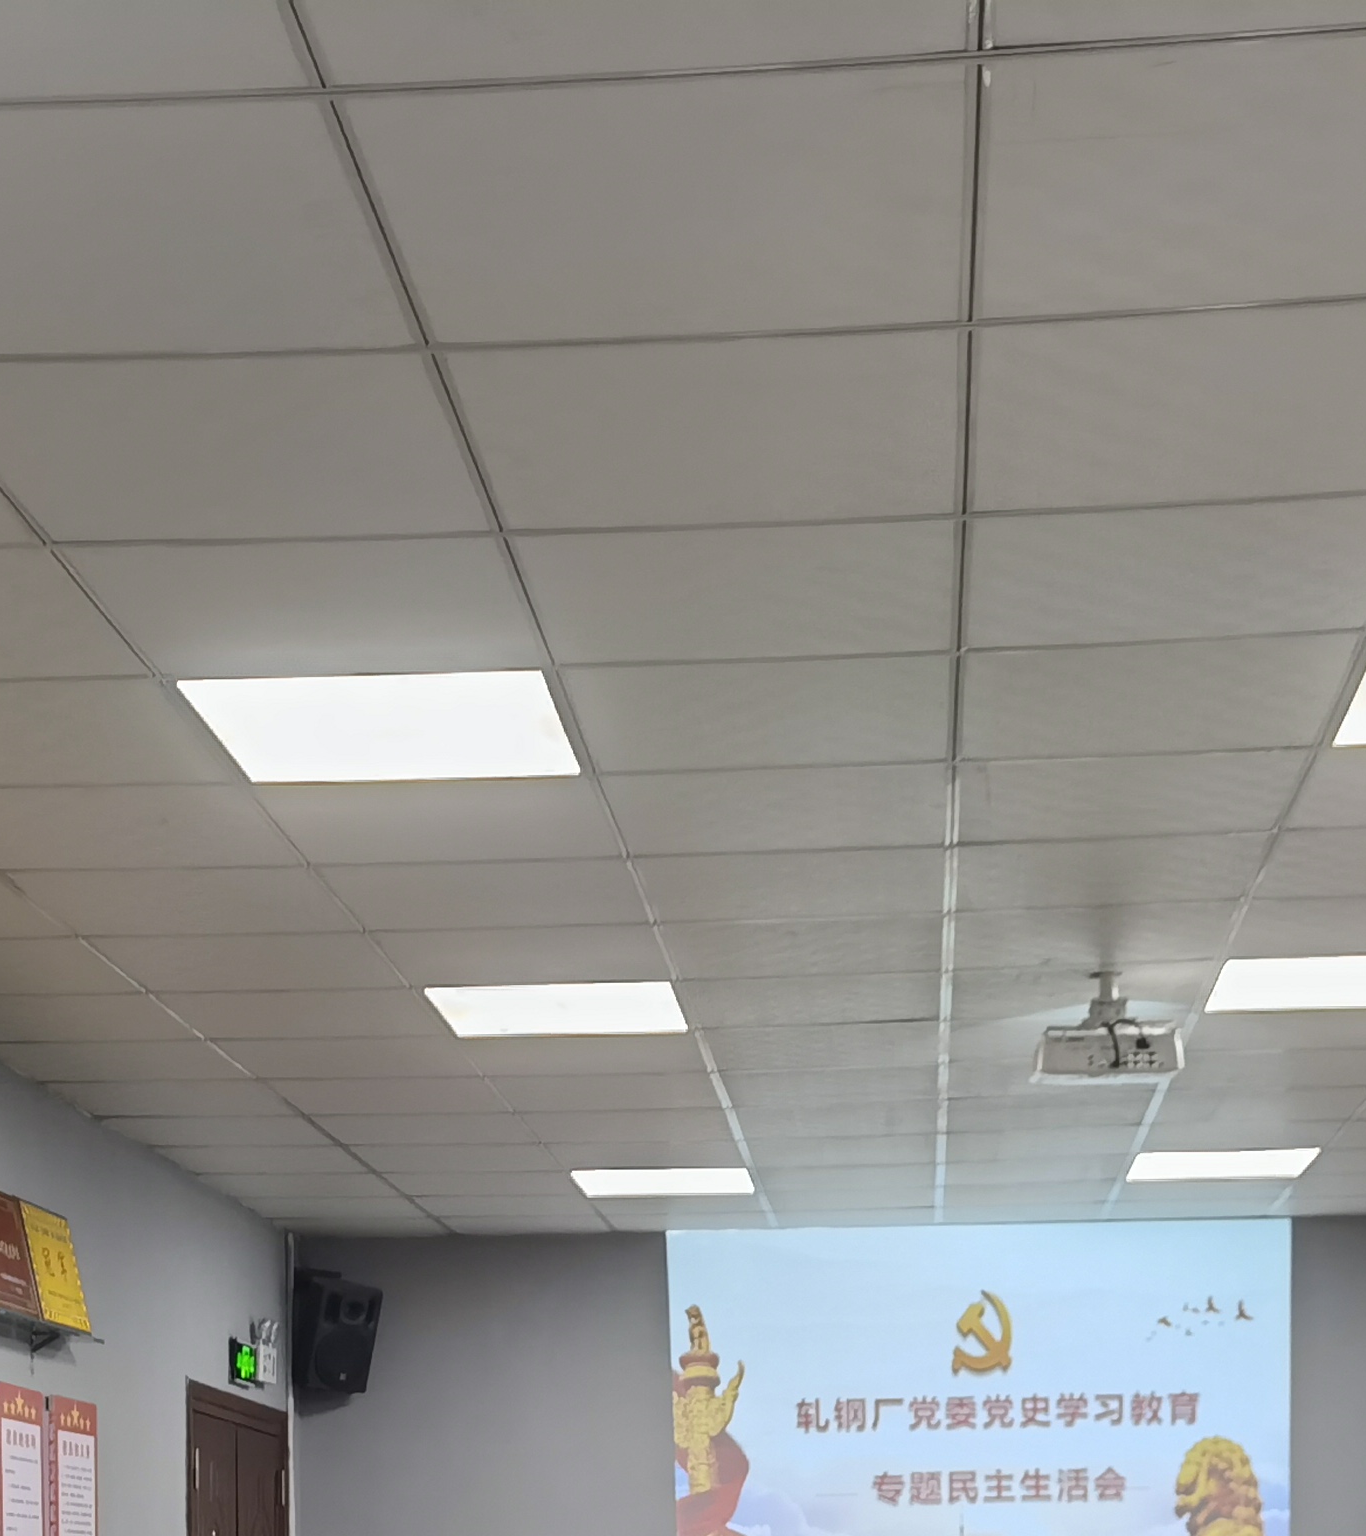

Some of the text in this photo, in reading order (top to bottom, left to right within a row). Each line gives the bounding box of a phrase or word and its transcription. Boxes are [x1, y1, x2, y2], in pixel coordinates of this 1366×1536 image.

[795, 1391, 1202, 1434] 轧钢厂党委党史学习教育
[872, 1466, 1128, 1506] 专题民主生活会
